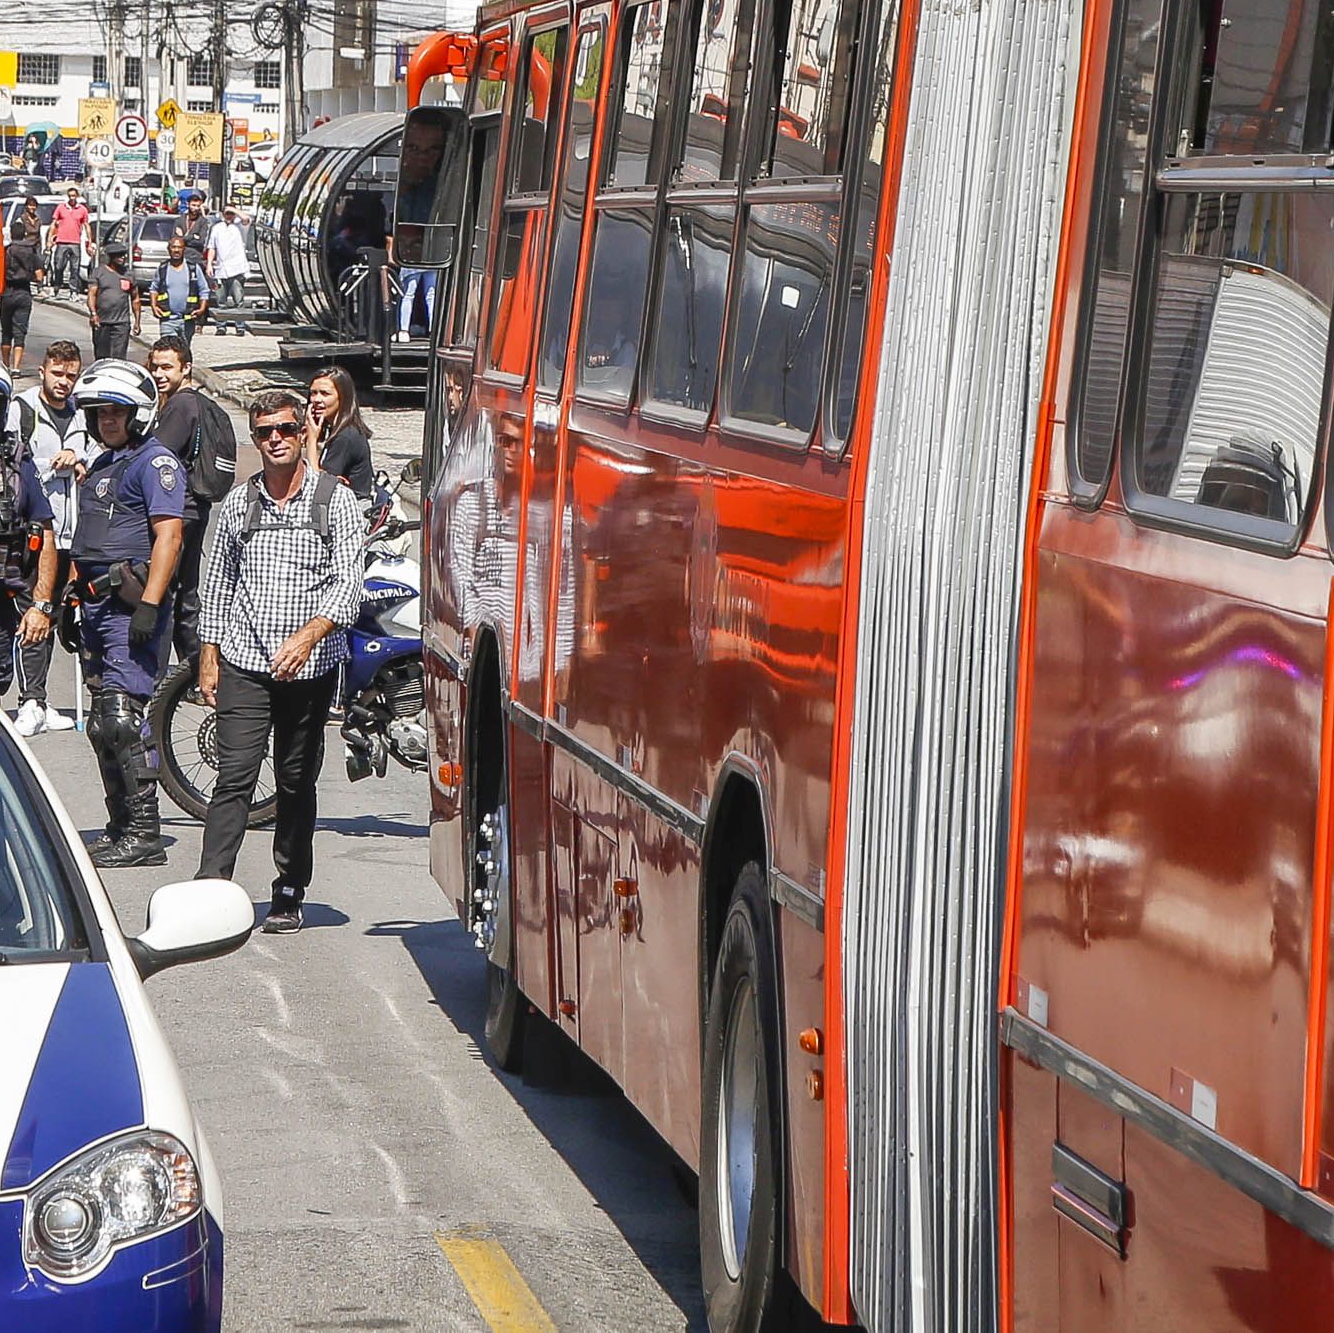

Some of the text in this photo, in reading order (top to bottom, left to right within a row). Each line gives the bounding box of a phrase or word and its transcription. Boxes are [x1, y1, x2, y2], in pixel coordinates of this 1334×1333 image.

[125, 122, 137, 140] E
[160, 134, 174, 145] 30
[90, 144, 110, 157] 40
